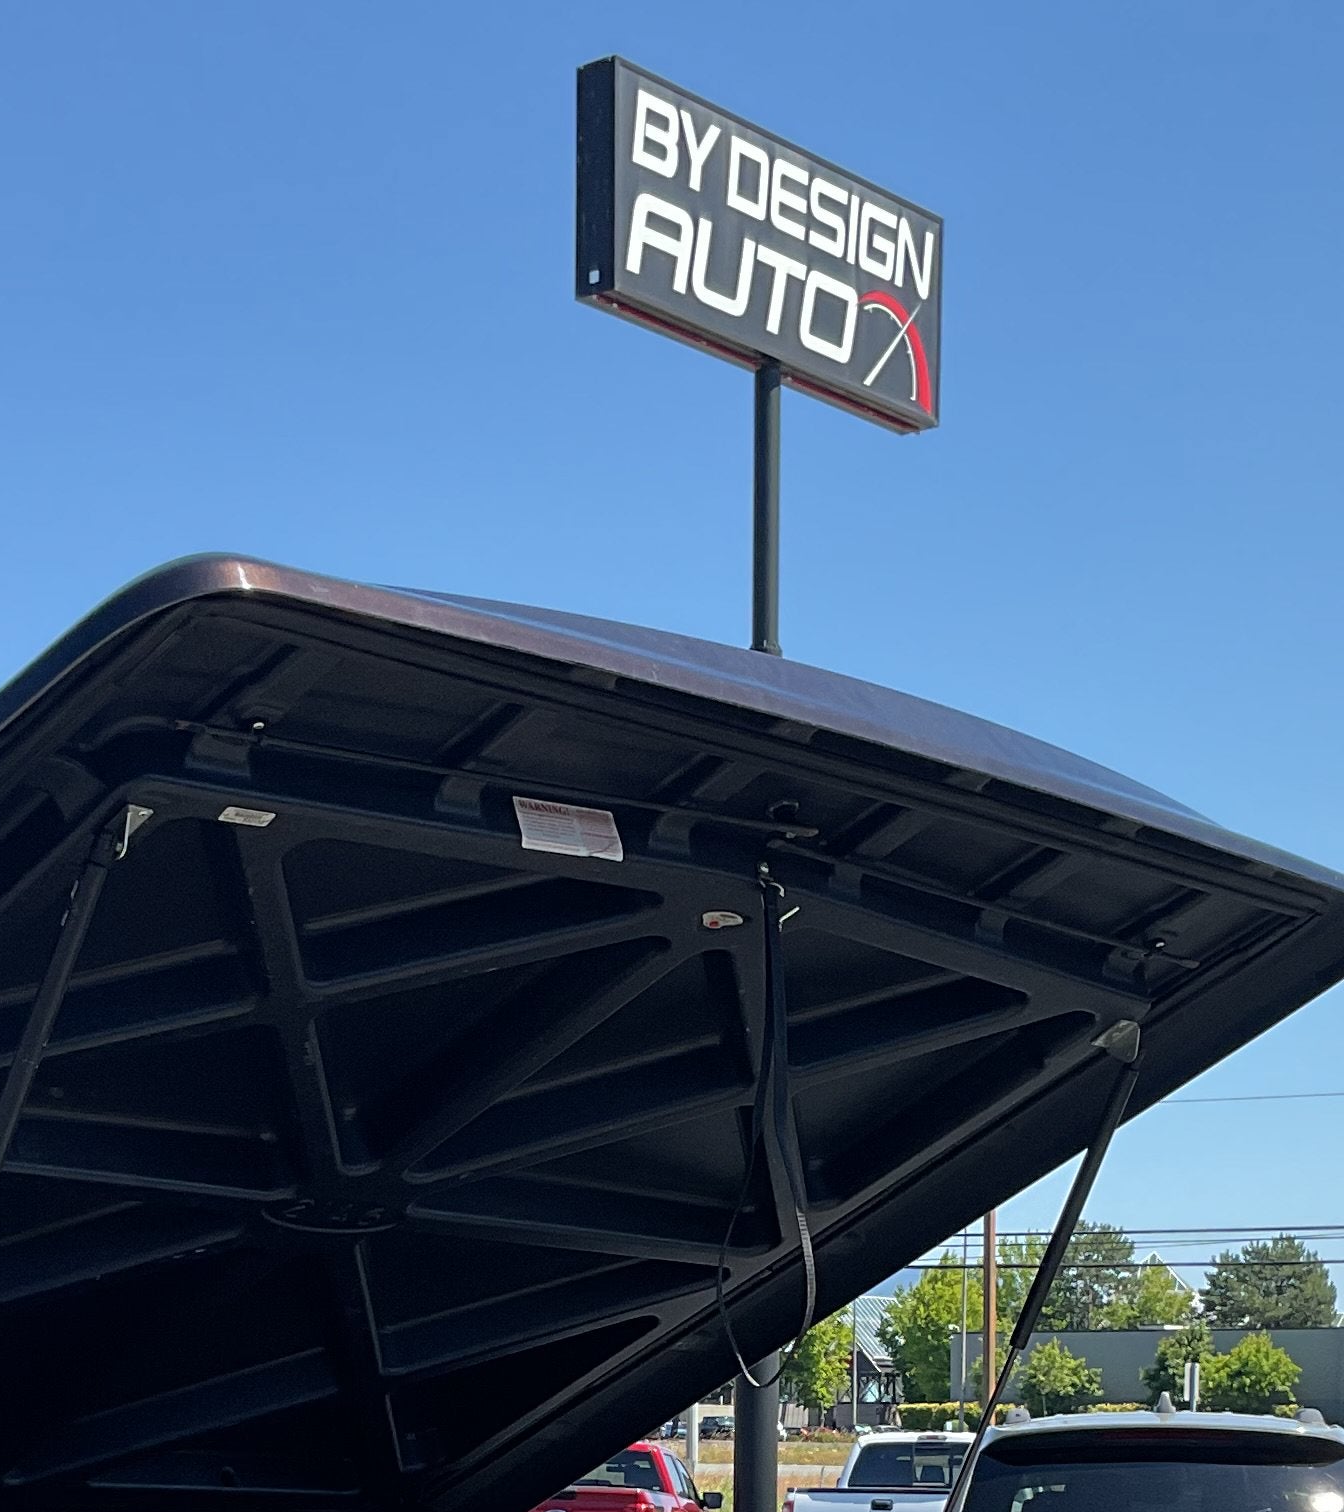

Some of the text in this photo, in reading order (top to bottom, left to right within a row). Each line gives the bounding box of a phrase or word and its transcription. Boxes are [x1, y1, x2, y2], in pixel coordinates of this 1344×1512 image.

[625, 192, 859, 364] AUTO
[632, 89, 935, 300] BY DESIGN
[518, 800, 571, 816] WARNING!
